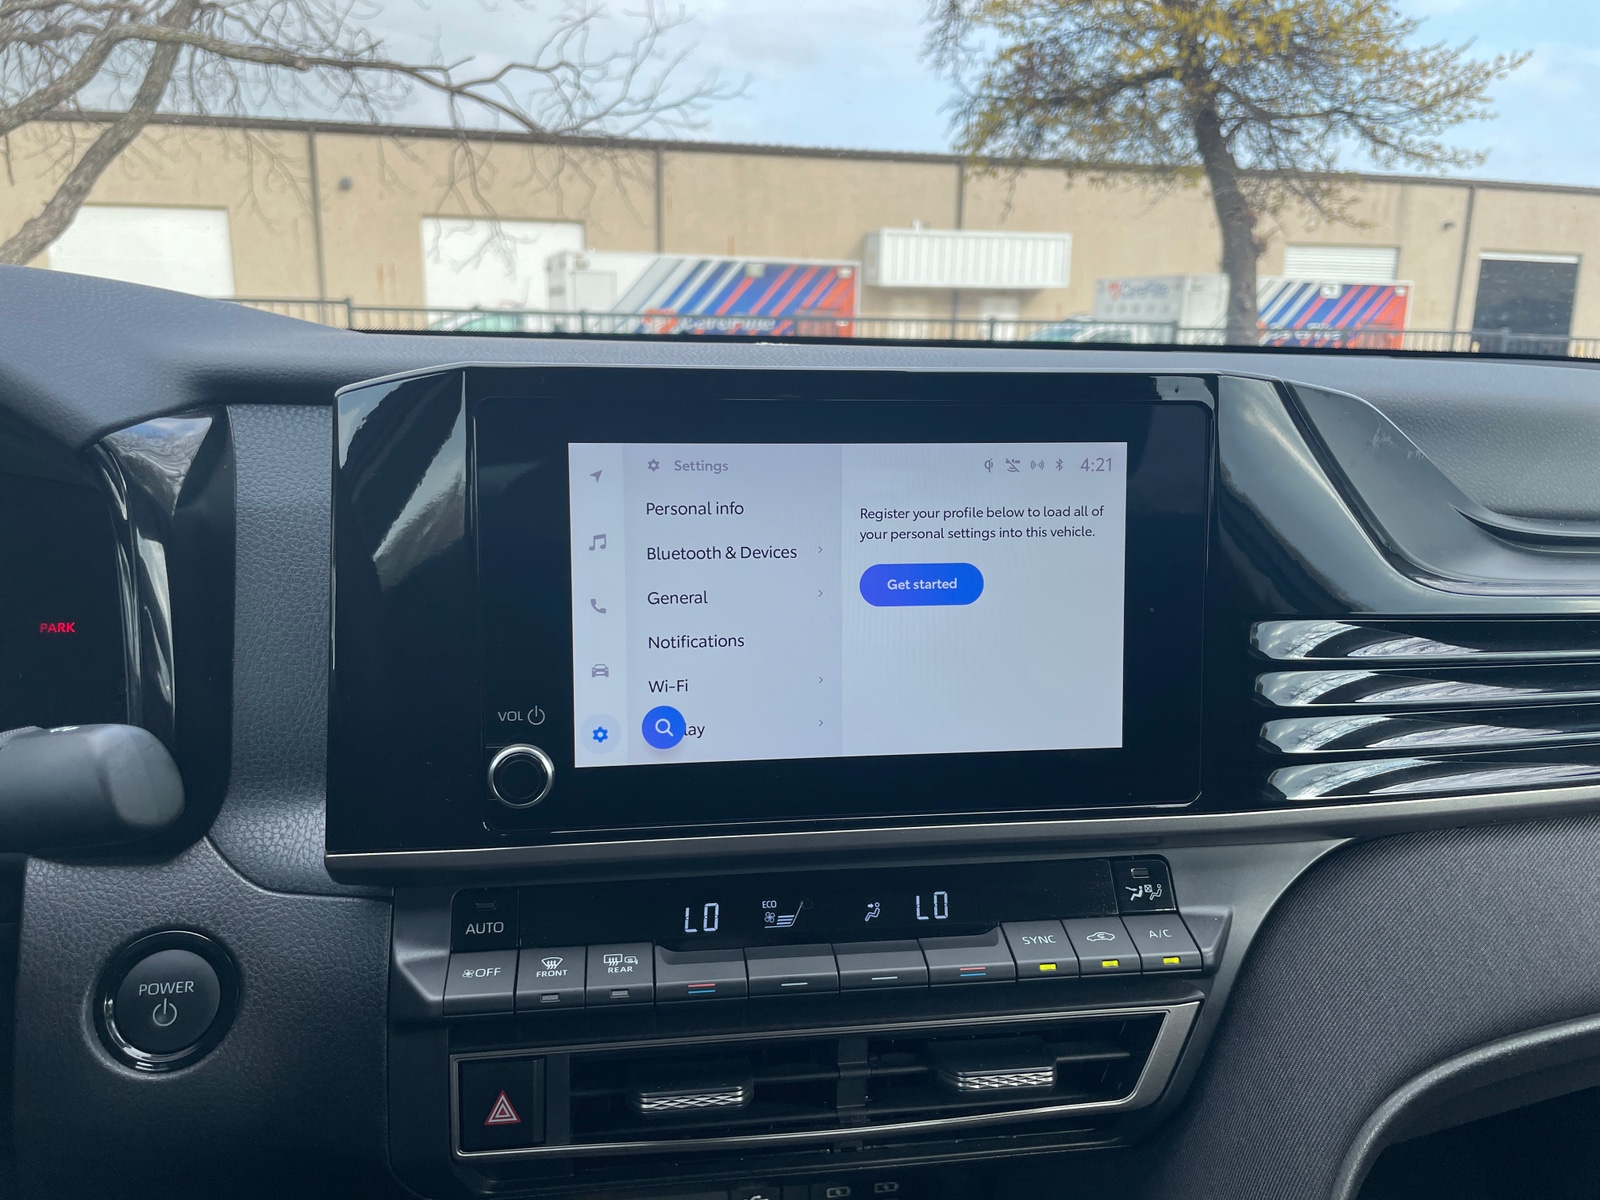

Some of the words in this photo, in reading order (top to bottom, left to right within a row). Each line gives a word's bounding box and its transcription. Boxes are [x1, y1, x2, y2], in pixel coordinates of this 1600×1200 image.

[674, 459, 729, 475] Settings
[1080, 457, 1113, 472] 4:21
[646, 501, 712, 516] Personal
[716, 501, 744, 515] info
[860, 507, 910, 522] Register
[912, 509, 941, 522] your
[943, 506, 984, 521] profile
[986, 506, 1025, 518] below
[1027, 507, 1040, 518] to
[1043, 506, 1071, 518] load
[1074, 505, 1089, 517] all
[1091, 505, 1105, 517] of
[859, 529, 888, 543] your
[890, 528, 945, 542] personal
[947, 527, 996, 541] settings
[999, 527, 1023, 539] into
[1026, 526, 1048, 538] this
[1050, 526, 1096, 538] vehicle.
[646, 546, 722, 561] Bluetooth
[726, 546, 737, 559] &
[740, 545, 798, 560] Devices
[887, 578, 911, 591] Get
[913, 577, 958, 591] started
[647, 590, 708, 605] General
[39, 621, 76, 633] PARK
[648, 634, 745, 650] Notifications
[648, 679, 689, 694] Wi-Fi
[497, 710, 524, 722] VOL
[761, 900, 778, 909] ECO
[465, 921, 505, 935] AUTO
[1149, 928, 1172, 939] A/C
[1021, 934, 1057, 945] SYNC
[475, 967, 502, 978] OFF
[536, 969, 568, 978] FRONT
[607, 965, 634, 974] REAR
[138, 980, 195, 997] POWER
